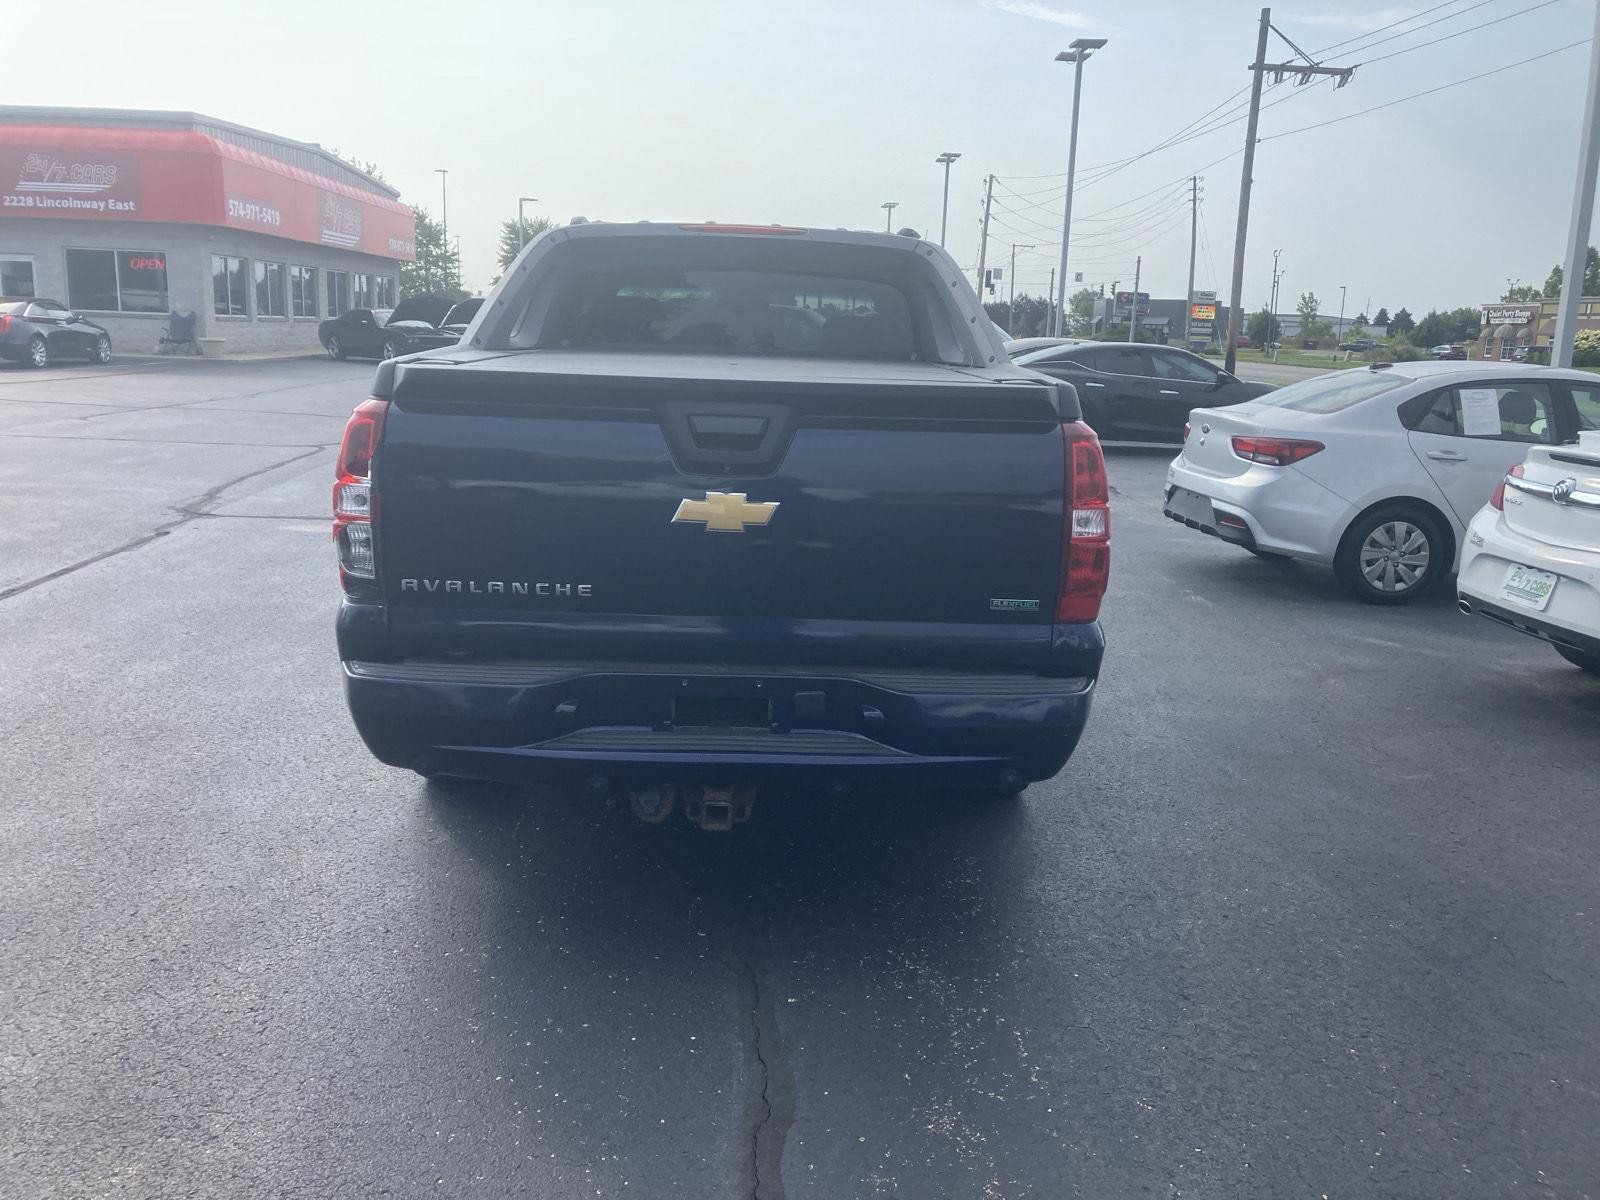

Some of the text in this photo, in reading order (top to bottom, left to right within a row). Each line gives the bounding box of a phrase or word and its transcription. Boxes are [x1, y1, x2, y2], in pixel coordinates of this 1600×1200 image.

[70, 163, 118, 185] CARS
[3, 196, 136, 211] 2228 Lincolnway East
[130, 257, 165, 270] OPEN
[401, 578, 593, 597] AVALANCHE
